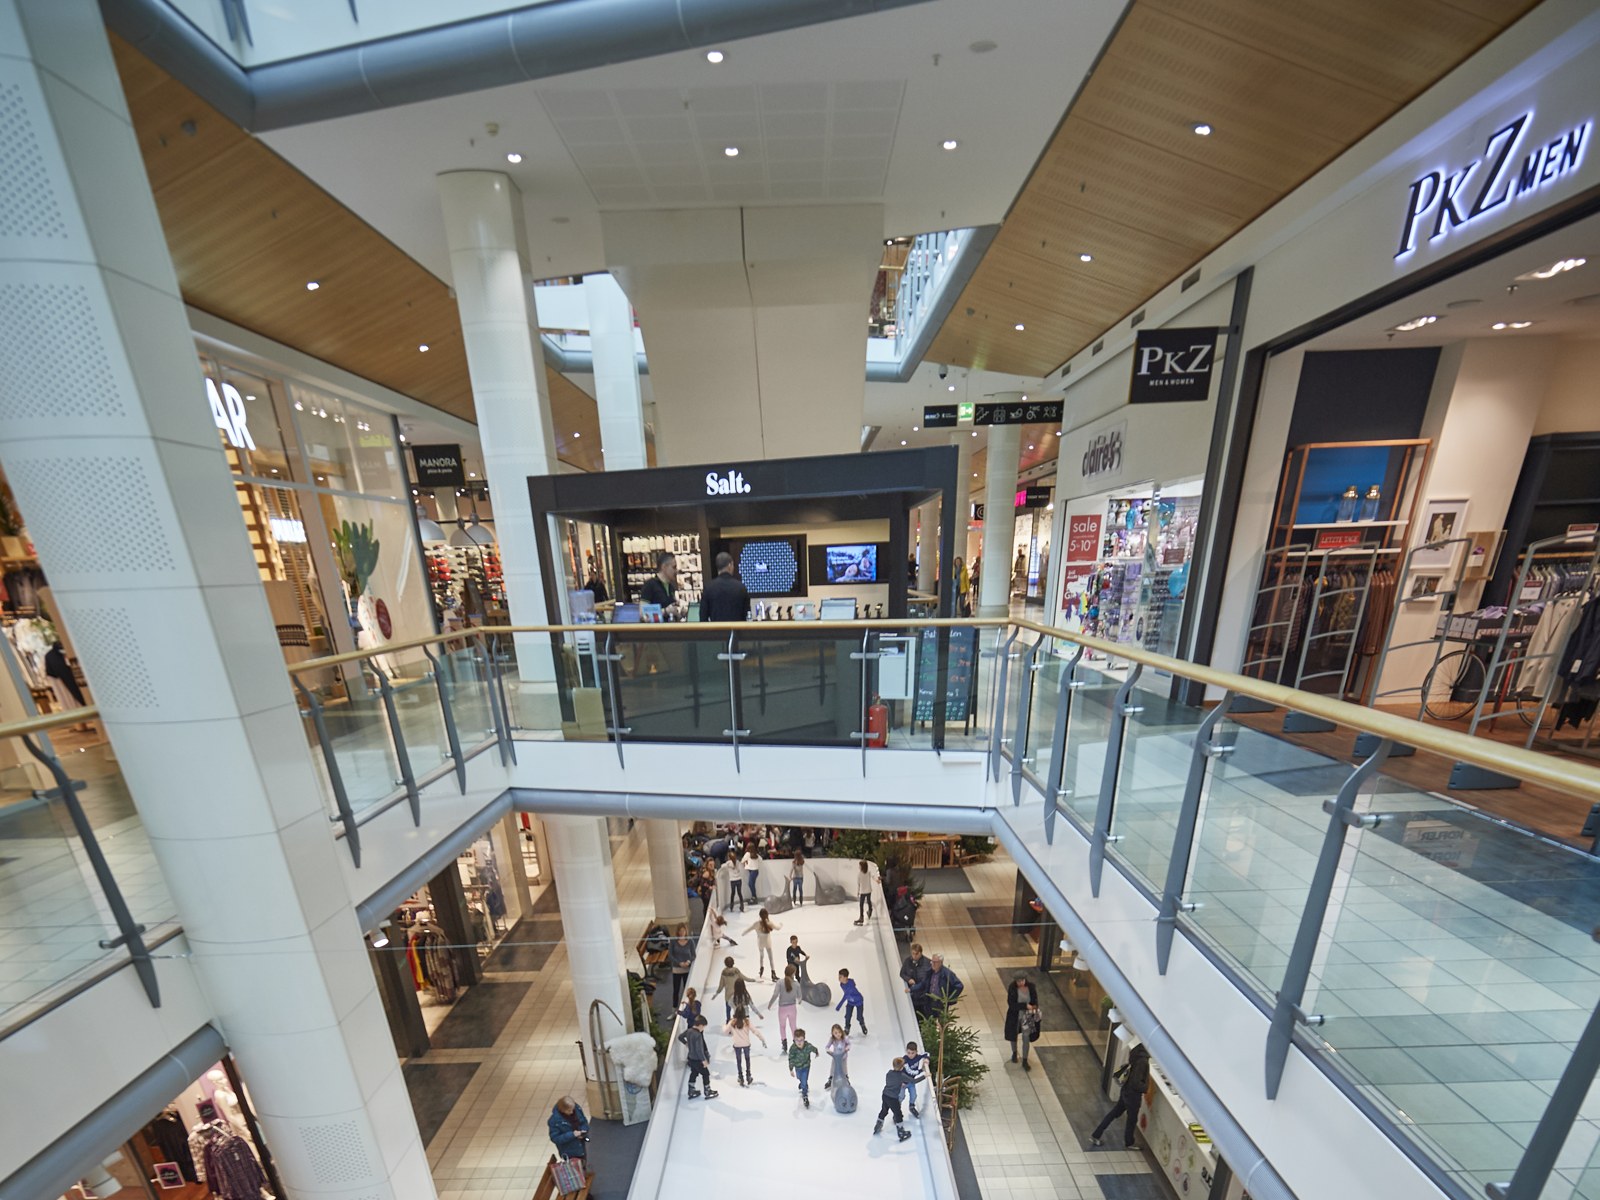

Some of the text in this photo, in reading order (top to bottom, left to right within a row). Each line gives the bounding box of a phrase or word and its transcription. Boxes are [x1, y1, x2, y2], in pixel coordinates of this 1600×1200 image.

[1393, 113, 1592, 262] PKZ MEN
[1137, 344, 1212, 376] PKZ
[1170, 378, 1195, 386] WOMEN
[419, 457, 458, 468] MANORA
[705, 469, 751, 496] Salt.
[1072, 517, 1098, 533] sale
